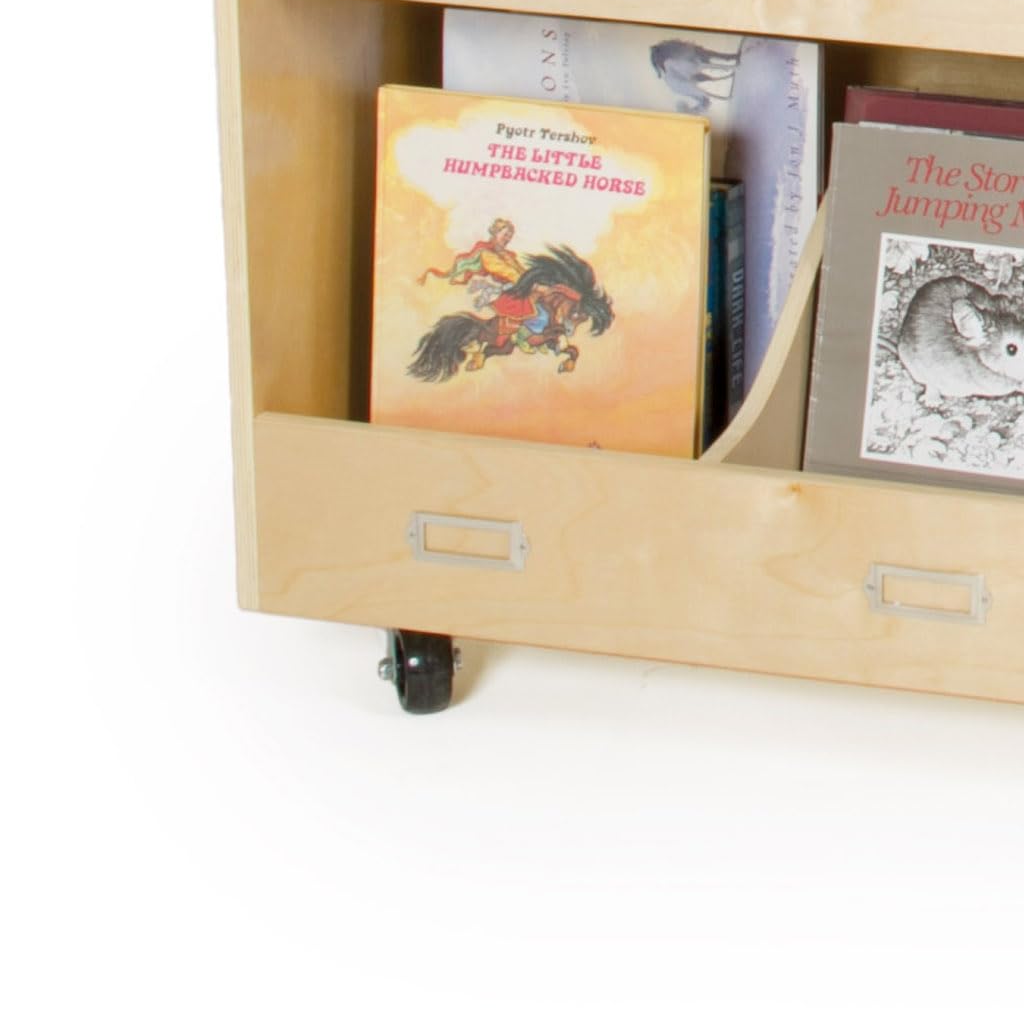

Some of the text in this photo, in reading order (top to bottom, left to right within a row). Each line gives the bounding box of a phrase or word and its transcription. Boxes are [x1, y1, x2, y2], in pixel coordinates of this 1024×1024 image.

[496, 123, 535, 139] Pyotr
[488, 143, 602, 170] THE LITTLE
[905, 154, 961, 187] The
[444, 158, 646, 196] HUMPBACKED HORSE
[876, 186, 1008, 234] Jumping
